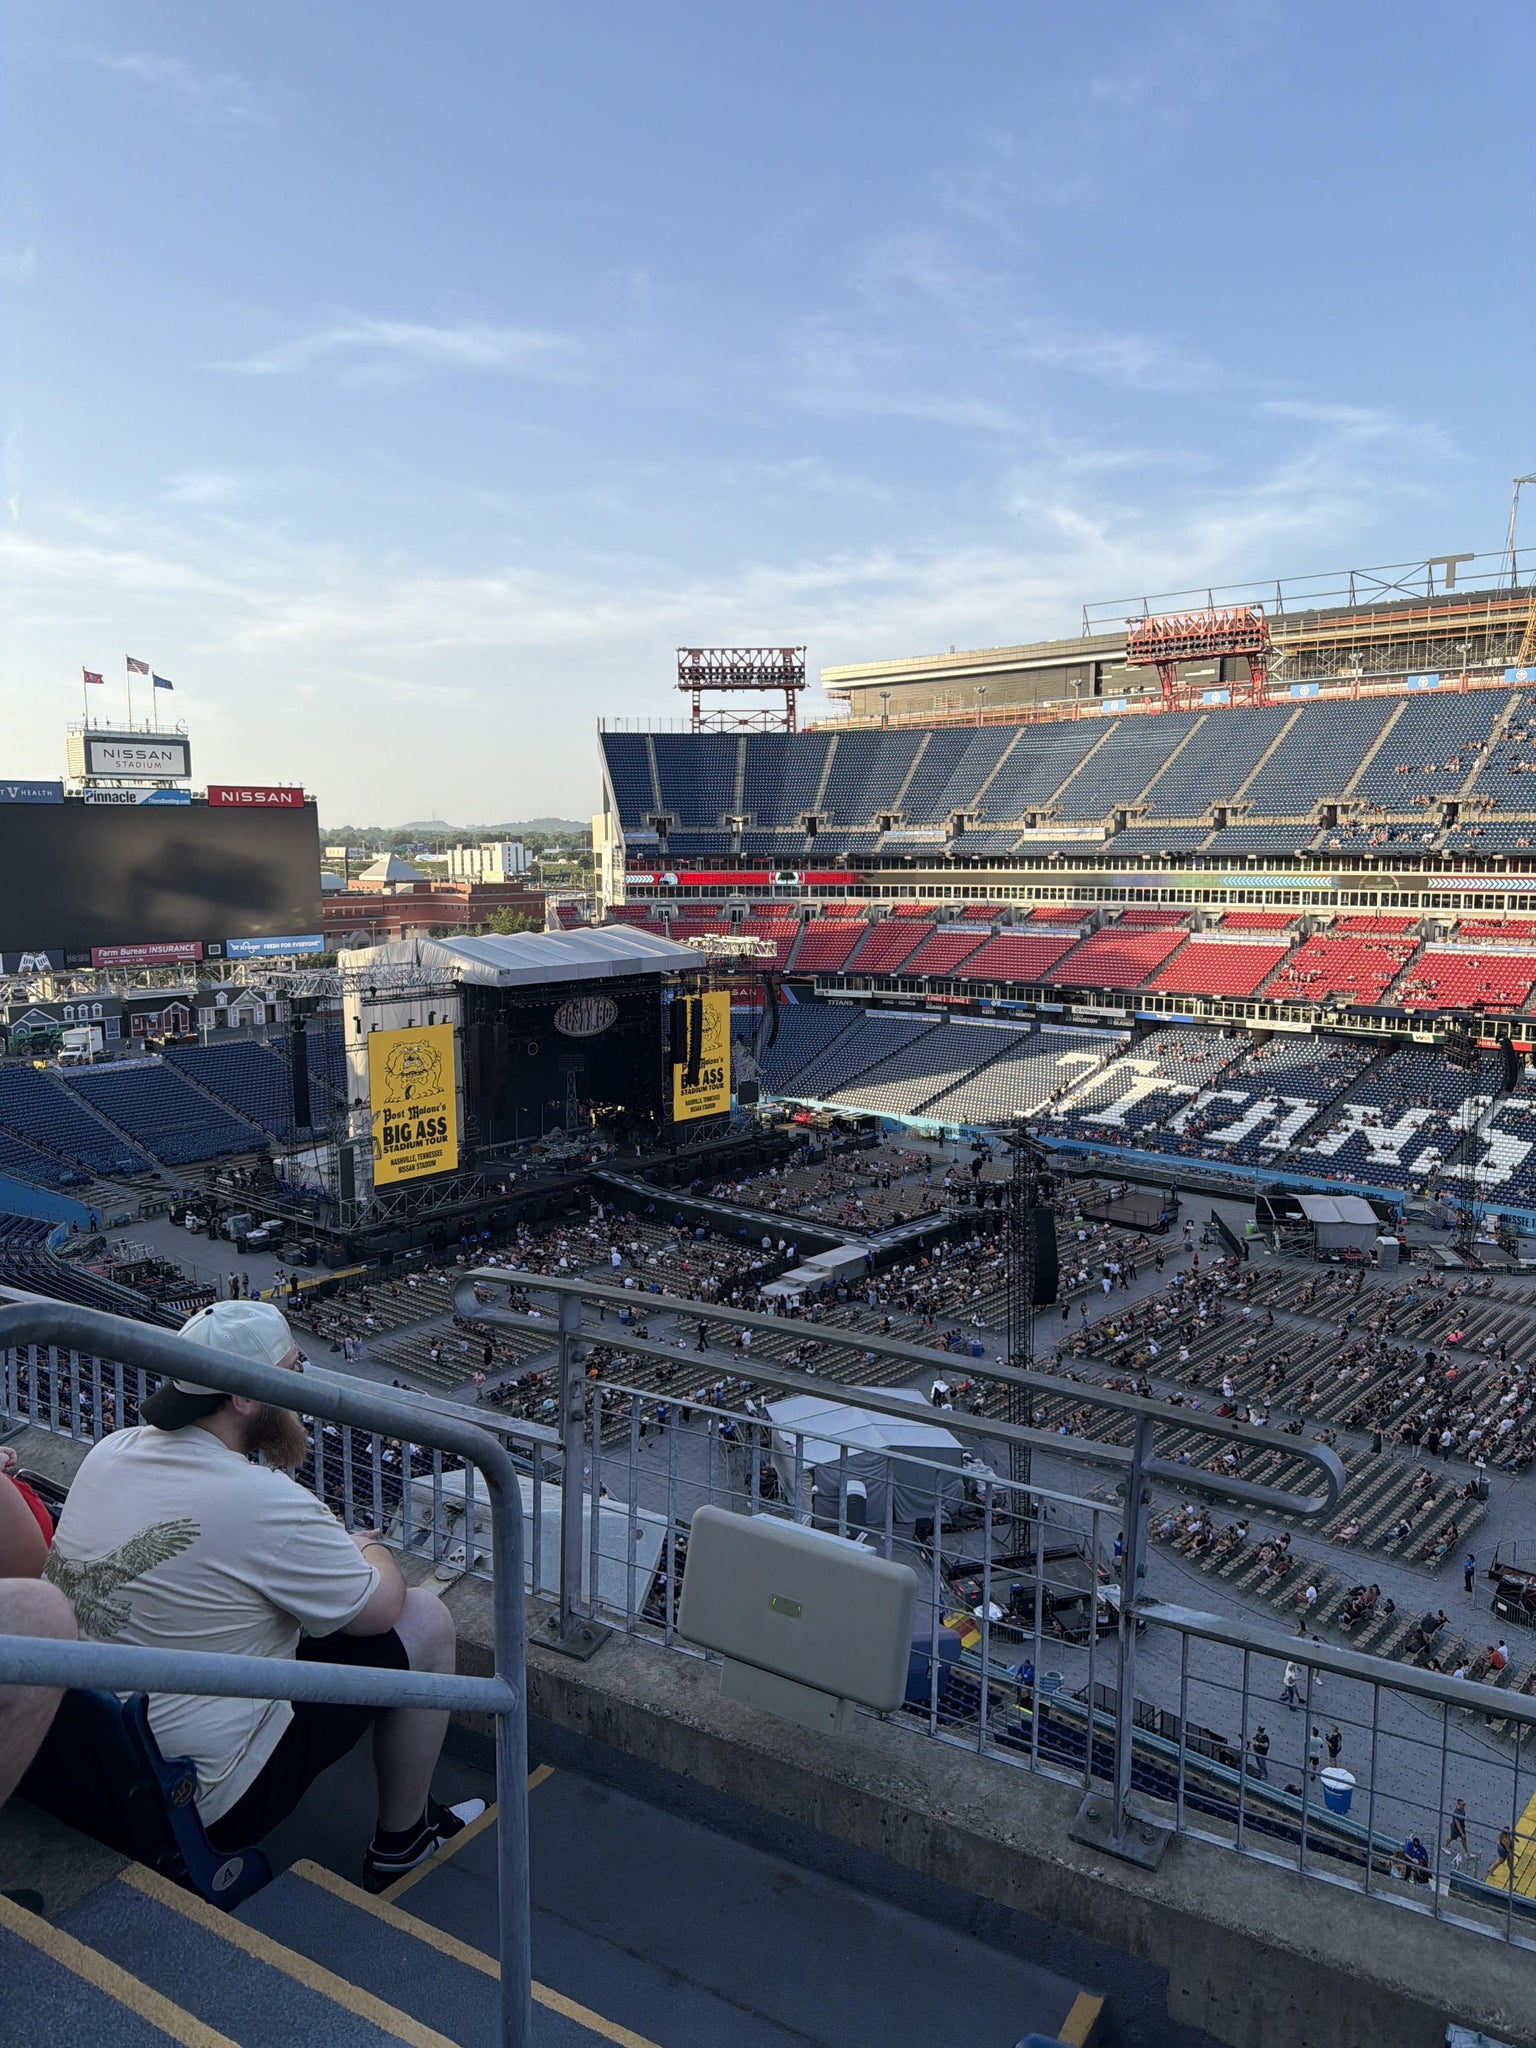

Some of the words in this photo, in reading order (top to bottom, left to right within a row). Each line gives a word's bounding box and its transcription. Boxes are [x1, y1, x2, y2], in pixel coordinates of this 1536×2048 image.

[1429, 553, 1474, 588] T
[104, 749, 172, 760] NISSAN
[115, 761, 162, 769] STADIUM
[20, 789, 53, 797] HEALTH
[86, 790, 137, 803] Pinnacle
[221, 791, 292, 803] NISSAN
[98, 949, 119, 957] Farm
[120, 947, 148, 956] Bureau
[148, 944, 196, 954] INSURANCE
[702, 1067, 724, 1085] ASS
[680, 1086, 708, 1096] STADIUM
[383, 1108, 405, 1126] Post
[408, 1103, 447, 1120] Malone's
[383, 1123, 412, 1146] BIG
[416, 1116, 447, 1139] ASS
[383, 1140, 423, 1154] STADIUM
[425, 1135, 448, 1146] TOUR
[417, 1149, 443, 1160] TENNESSEE
[416, 1159, 437, 1170] STADIUM
[222, 1867, 234, 1885] A
